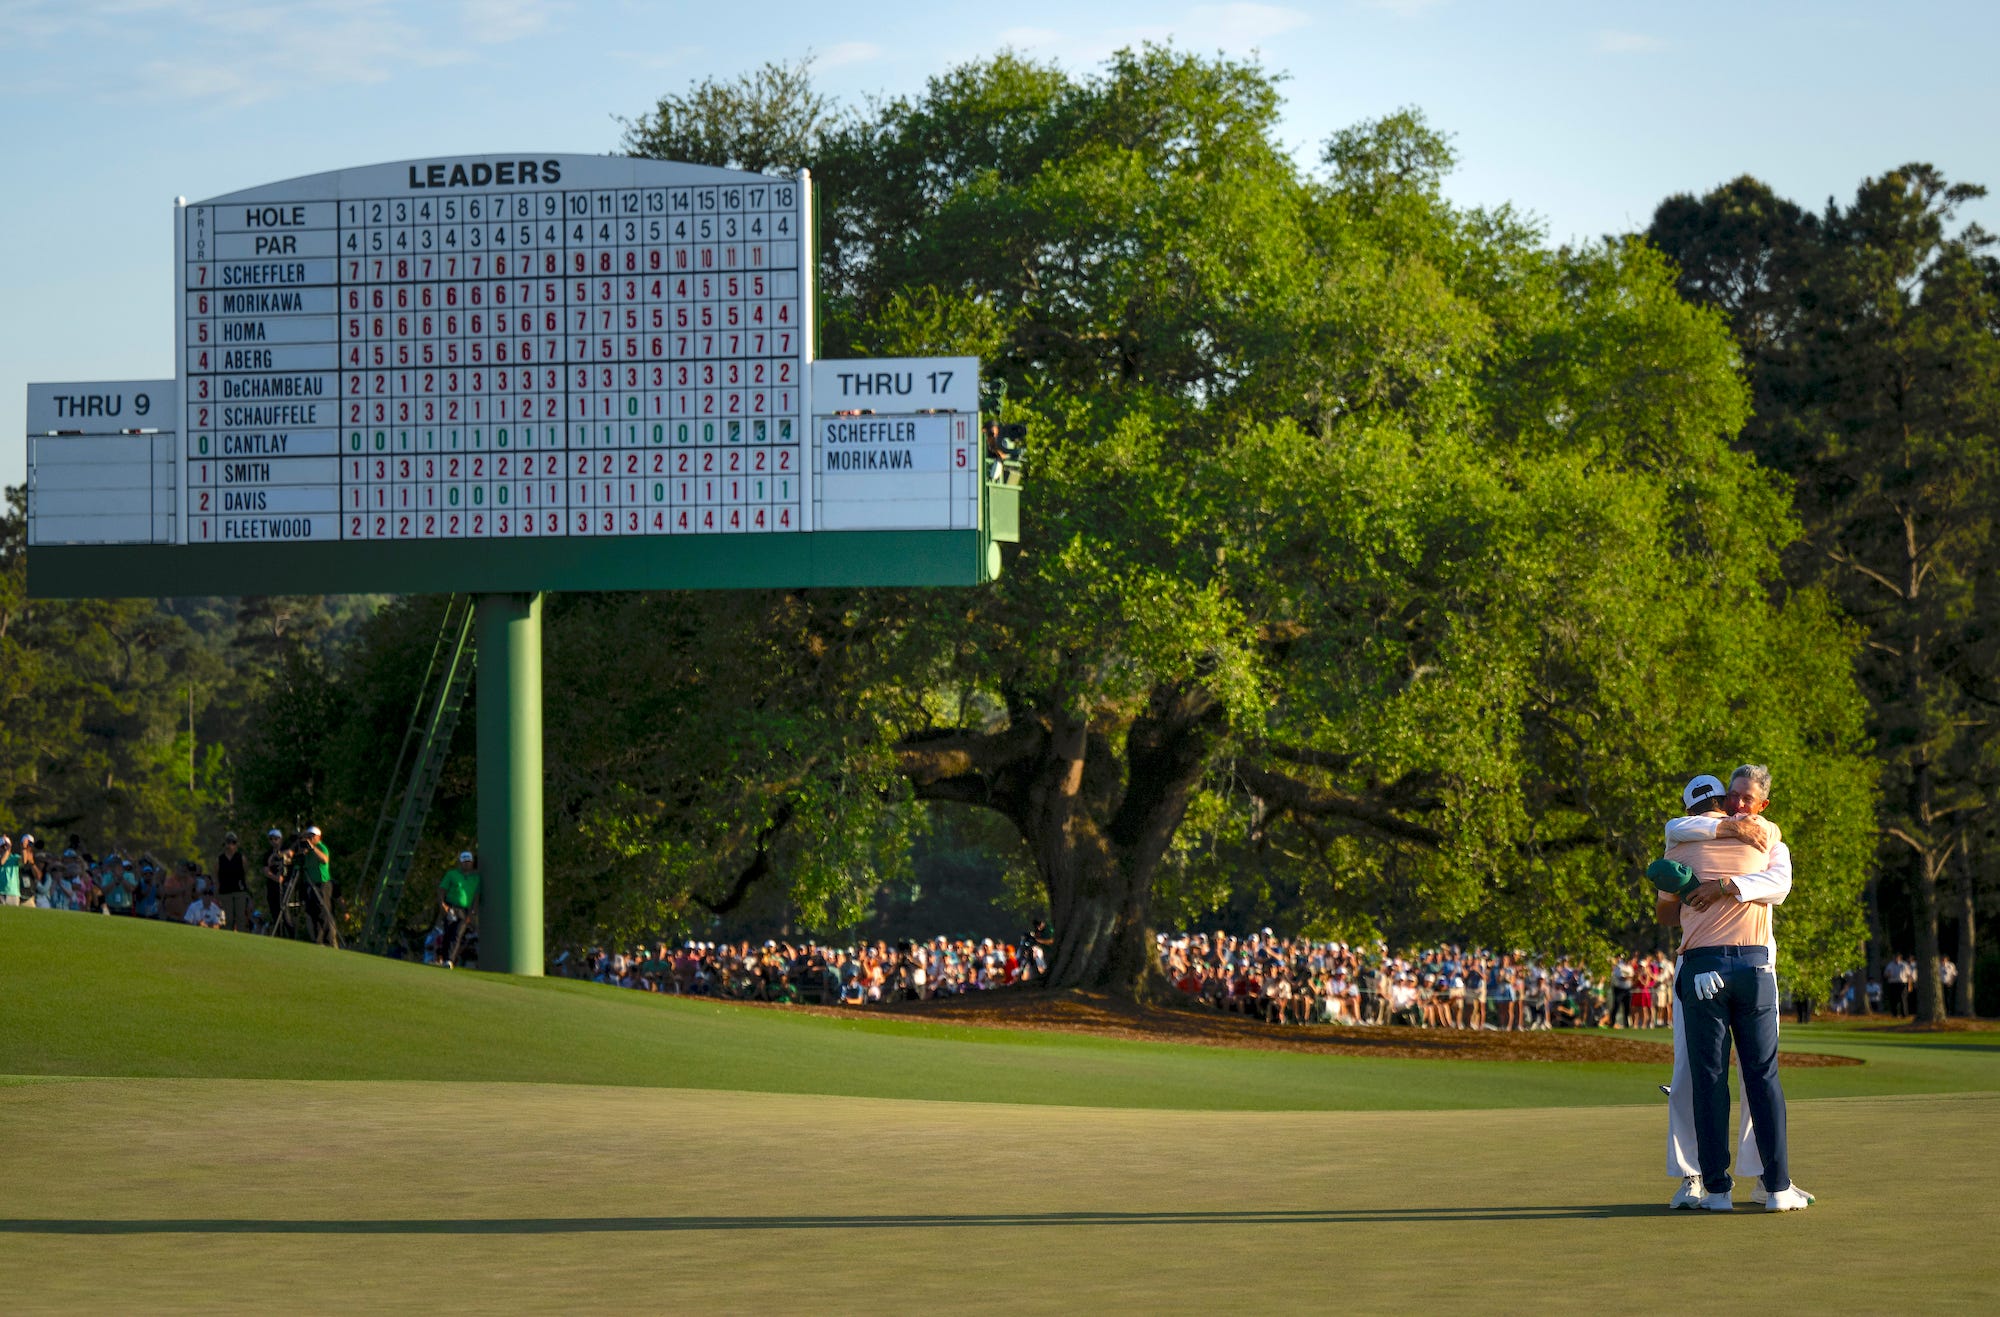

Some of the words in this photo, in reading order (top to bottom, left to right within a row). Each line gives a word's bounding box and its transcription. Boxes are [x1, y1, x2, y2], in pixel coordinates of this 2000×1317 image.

[409, 160, 562, 189] LEADERS
[246, 208, 305, 227] HOLE
[349, 205, 355, 223] 1
[372, 203, 382, 223] 2
[396, 203, 406, 222] 3
[420, 202, 431, 220] 4
[445, 200, 456, 220] 5
[470, 199, 480, 219] 6
[494, 198, 504, 217] 7
[518, 197, 528, 217] 8
[545, 196, 556, 216] 9
[570, 195, 587, 215] 10
[598, 195, 611, 213] 11
[622, 193, 638, 212] 12
[646, 192, 663, 212] 13
[672, 192, 689, 210] 14
[697, 191, 715, 210] 15
[723, 189, 740, 209] 16
[749, 188, 765, 208] 17
[775, 187, 793, 207] 18
[256, 236, 296, 254] PAR
[347, 233, 357, 251] 4
[372, 232, 382, 251] 5
[397, 231, 407, 249] 4
[422, 230, 432, 249] 3
[446, 229, 456, 247] 4
[471, 227, 481, 247] 3
[495, 227, 505, 245] 4
[520, 226, 530, 245] 5
[545, 225, 556, 243] 4
[573, 224, 584, 242] 4
[599, 223, 610, 241] 4
[625, 222, 635, 241] 3
[650, 221, 660, 241] 5
[675, 220, 686, 239] 4
[701, 219, 711, 239] 5
[726, 218, 737, 238] 3
[751, 217, 762, 236] 4
[778, 216, 789, 235] 4
[200, 267, 207, 285] 7
[223, 263, 304, 283] SCHEFFLER
[351, 261, 359, 281] 7
[375, 260, 383, 279] 7
[397, 259, 408, 279] 8
[424, 258, 432, 278] 7
[448, 258, 456, 277] 7
[472, 257, 481, 276] 7
[496, 256, 506, 275] 6
[522, 255, 530, 273] 7
[546, 254, 556, 273] 8
[575, 253, 586, 273] 9
[600, 252, 611, 272] 8
[626, 252, 636, 270] 8
[649, 250, 661, 270] 9
[676, 250, 687, 269] 10
[701, 248, 713, 268] 10
[727, 247, 736, 265] 11
[753, 247, 762, 266] 11
[198, 295, 208, 314] 6
[224, 293, 302, 311] MORIKAWA
[349, 290, 359, 309] 6
[373, 289, 383, 308] 6
[398, 289, 408, 307] 6
[422, 287, 432, 307] 6
[447, 287, 456, 306] 6
[471, 286, 482, 305] 6
[496, 284, 506, 305] 6
[521, 284, 529, 303] 7
[546, 283, 556, 303] 5
[576, 282, 586, 302] 5
[602, 281, 611, 301] 3
[626, 280, 636, 301] 3
[651, 280, 661, 298] 4
[676, 280, 686, 297] 4
[703, 278, 711, 297] 5
[728, 277, 738, 296] 5
[754, 276, 764, 296] 5
[199, 322, 208, 343] 5
[224, 322, 266, 340] HOMA
[350, 319, 360, 338] 5
[374, 318, 383, 337] 6
[398, 317, 408, 336] 6
[423, 317, 432, 335] 6
[448, 315, 457, 334] 6
[471, 314, 482, 334] 6
[497, 313, 507, 332] 5
[521, 313, 531, 332] 6
[545, 312, 556, 331] 6
[576, 311, 587, 331] 7
[602, 310, 611, 330] 7
[626, 309, 637, 329] 5
[199, 352, 209, 369] 4
[224, 349, 272, 368] ABERG
[199, 379, 208, 398] 3
[224, 377, 322, 397] DeCHAMBEAU
[351, 376, 360, 395] 2
[375, 375, 385, 393] 2
[401, 374, 407, 392] 1
[425, 373, 433, 392] 2
[449, 373, 458, 391] 3
[473, 372, 482, 391] 3
[498, 371, 508, 390] 3
[522, 370, 532, 390] 3
[546, 369, 556, 389] 3
[578, 369, 587, 388] 3
[602, 368, 613, 388] 3
[627, 367, 637, 387] 3
[653, 367, 663, 387] 3
[678, 366, 688, 385] 3
[704, 364, 714, 385] 3
[729, 364, 739, 383] 3
[754, 364, 764, 383] 2
[780, 363, 790, 383] 2
[837, 372, 912, 396] THRU
[927, 372, 953, 394] 17
[53, 395, 121, 417] THRU
[135, 394, 150, 416] 9
[199, 408, 208, 427] 2
[224, 405, 316, 424] SCHAUFFELE
[827, 422, 915, 443] SCHEFFLER
[956, 421, 965, 440] 11
[197, 436, 208, 455] 0
[224, 434, 288, 453] CANTLAY
[827, 450, 912, 470] MORIKAWA
[956, 449, 966, 468] 5
[202, 464, 207, 483] 1
[225, 463, 269, 483] SMITH
[200, 493, 209, 511] 2
[225, 491, 266, 511] DAVIS
[202, 520, 208, 539] 1
[225, 519, 311, 538] FLEETWOOD
[352, 516, 361, 536] 2
[376, 516, 385, 537] 2
[400, 516, 410, 535] 2
[425, 515, 435, 535] 2
[449, 514, 460, 534] 2
[474, 514, 483, 534] 2
[499, 514, 508, 534] 3
[525, 514, 533, 533] 3
[548, 513, 558, 532] 3
[578, 513, 587, 532] 3
[604, 512, 613, 531] 3
[629, 512, 639, 531] 3
[654, 512, 663, 530] 4
[679, 511, 688, 529] 4
[704, 511, 713, 528] 4
[731, 510, 739, 528] 4
[755, 509, 765, 527] 4
[780, 509, 789, 528] 4
